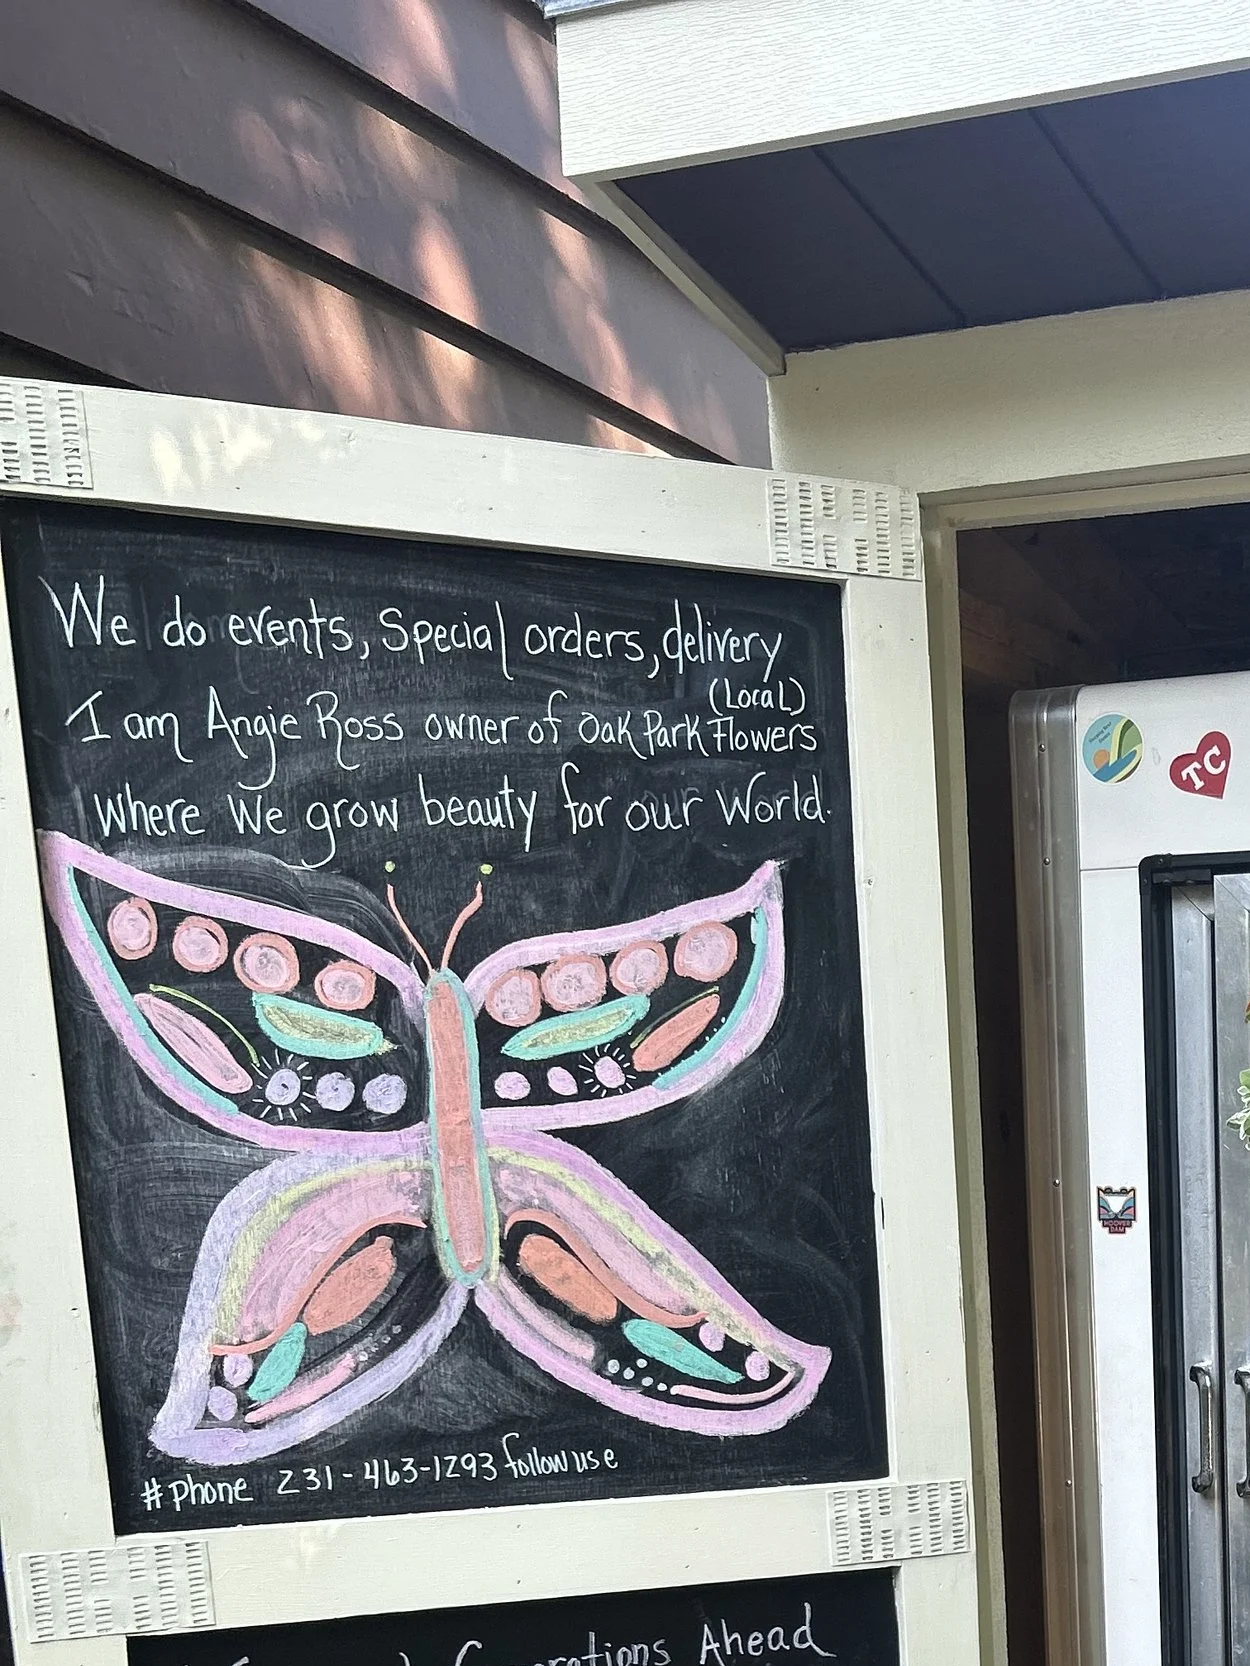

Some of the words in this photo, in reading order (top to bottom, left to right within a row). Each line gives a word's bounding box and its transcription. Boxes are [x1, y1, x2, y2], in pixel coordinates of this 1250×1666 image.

[38, 574, 136, 648] We
[163, 594, 207, 647] do
[228, 597, 370, 660] events,
[379, 600, 514, 680] Special
[524, 611, 660, 679] orders,
[662, 598, 783, 683] delivery
[64, 690, 112, 742] I
[123, 712, 194, 763] am
[206, 685, 302, 791] Angie
[305, 690, 404, 771] Ross
[425, 712, 520, 745] owner
[527, 689, 568, 745] of
[707, 715, 818, 753] Flowers
[1180, 744, 1227, 792] TC
[301, 798, 398, 869] grow
[417, 772, 537, 853] beauty
[560, 761, 613, 835] for
[624, 797, 704, 832] our
[1104, 1219, 1131, 1227] HOOVER
[500, 1432, 570, 1480] follow
